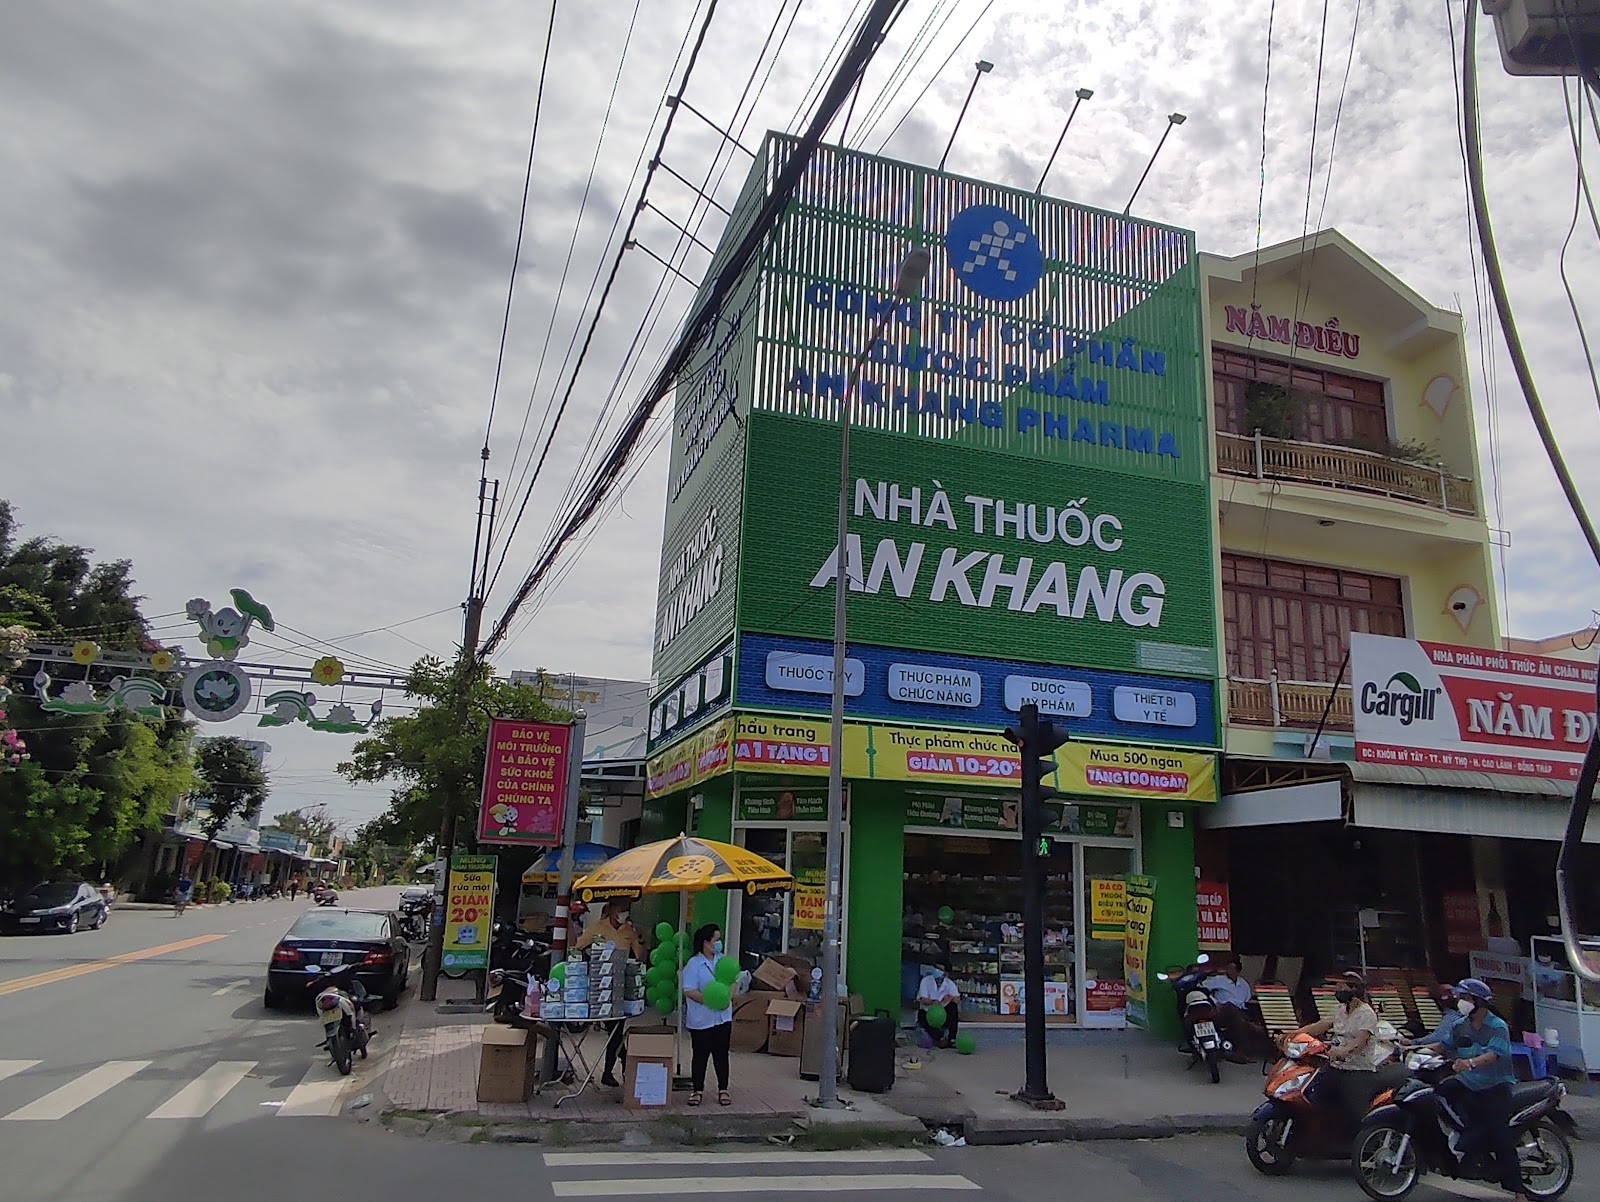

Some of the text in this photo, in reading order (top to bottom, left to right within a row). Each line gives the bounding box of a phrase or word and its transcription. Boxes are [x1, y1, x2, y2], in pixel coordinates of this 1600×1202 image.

[1225, 302, 1361, 360] NĂM ĐIỀU
[1017, 408, 1181, 459] PHARMA
[854, 477, 1123, 552] NHÀ THUỐC
[668, 505, 718, 594] NHÀ THUỐC
[809, 533, 1166, 628] AN KHANG
[659, 543, 724, 652] AN KHANG
[1433, 649, 1454, 664] NHÀ
[1456, 651, 1483, 668] PHÂN
[1486, 653, 1509, 670] PHỐI
[1511, 658, 1537, 673] THỨC
[1539, 662, 1552, 675] ĂN
[778, 665, 853, 683] THUỐC TY
[899, 686, 935, 701] CHỨC
[1361, 681, 1436, 726] Cargill
[1143, 709, 1168, 722] Y TẾ
[1466, 691, 1555, 740] NĂM
[512, 728, 550, 742] BẢO VỆ
[736, 718, 817, 743] hẩu trang
[496, 741, 517, 751] MÔI
[889, 732, 922, 749] Thực
[924, 733, 965, 751] phẩm
[968, 737, 998, 751] chức
[501, 754, 514, 764] LÀ
[518, 755, 539, 765] BẢO
[752, 742, 762, 759] 1
[767, 743, 818, 765] TẶNG
[820, 746, 830, 763] 1
[1090, 749, 1183, 769] Mua 500 ngàn
[501, 766, 522, 777] SỨC
[909, 754, 1022, 776] GIẢM 10-20%
[497, 777, 555, 792] CỦA CHÍNH
[1088, 769, 1188, 790] TẶNG 100 NGÀN
[497, 792, 552, 805] CHÚNG TA
[451, 892, 489, 905] GIẢM
[449, 908, 488, 923] 20%
[796, 909, 814, 919] 100
[1201, 908, 1214, 923] VÀ
[1216, 908, 1228, 923] LẺ
